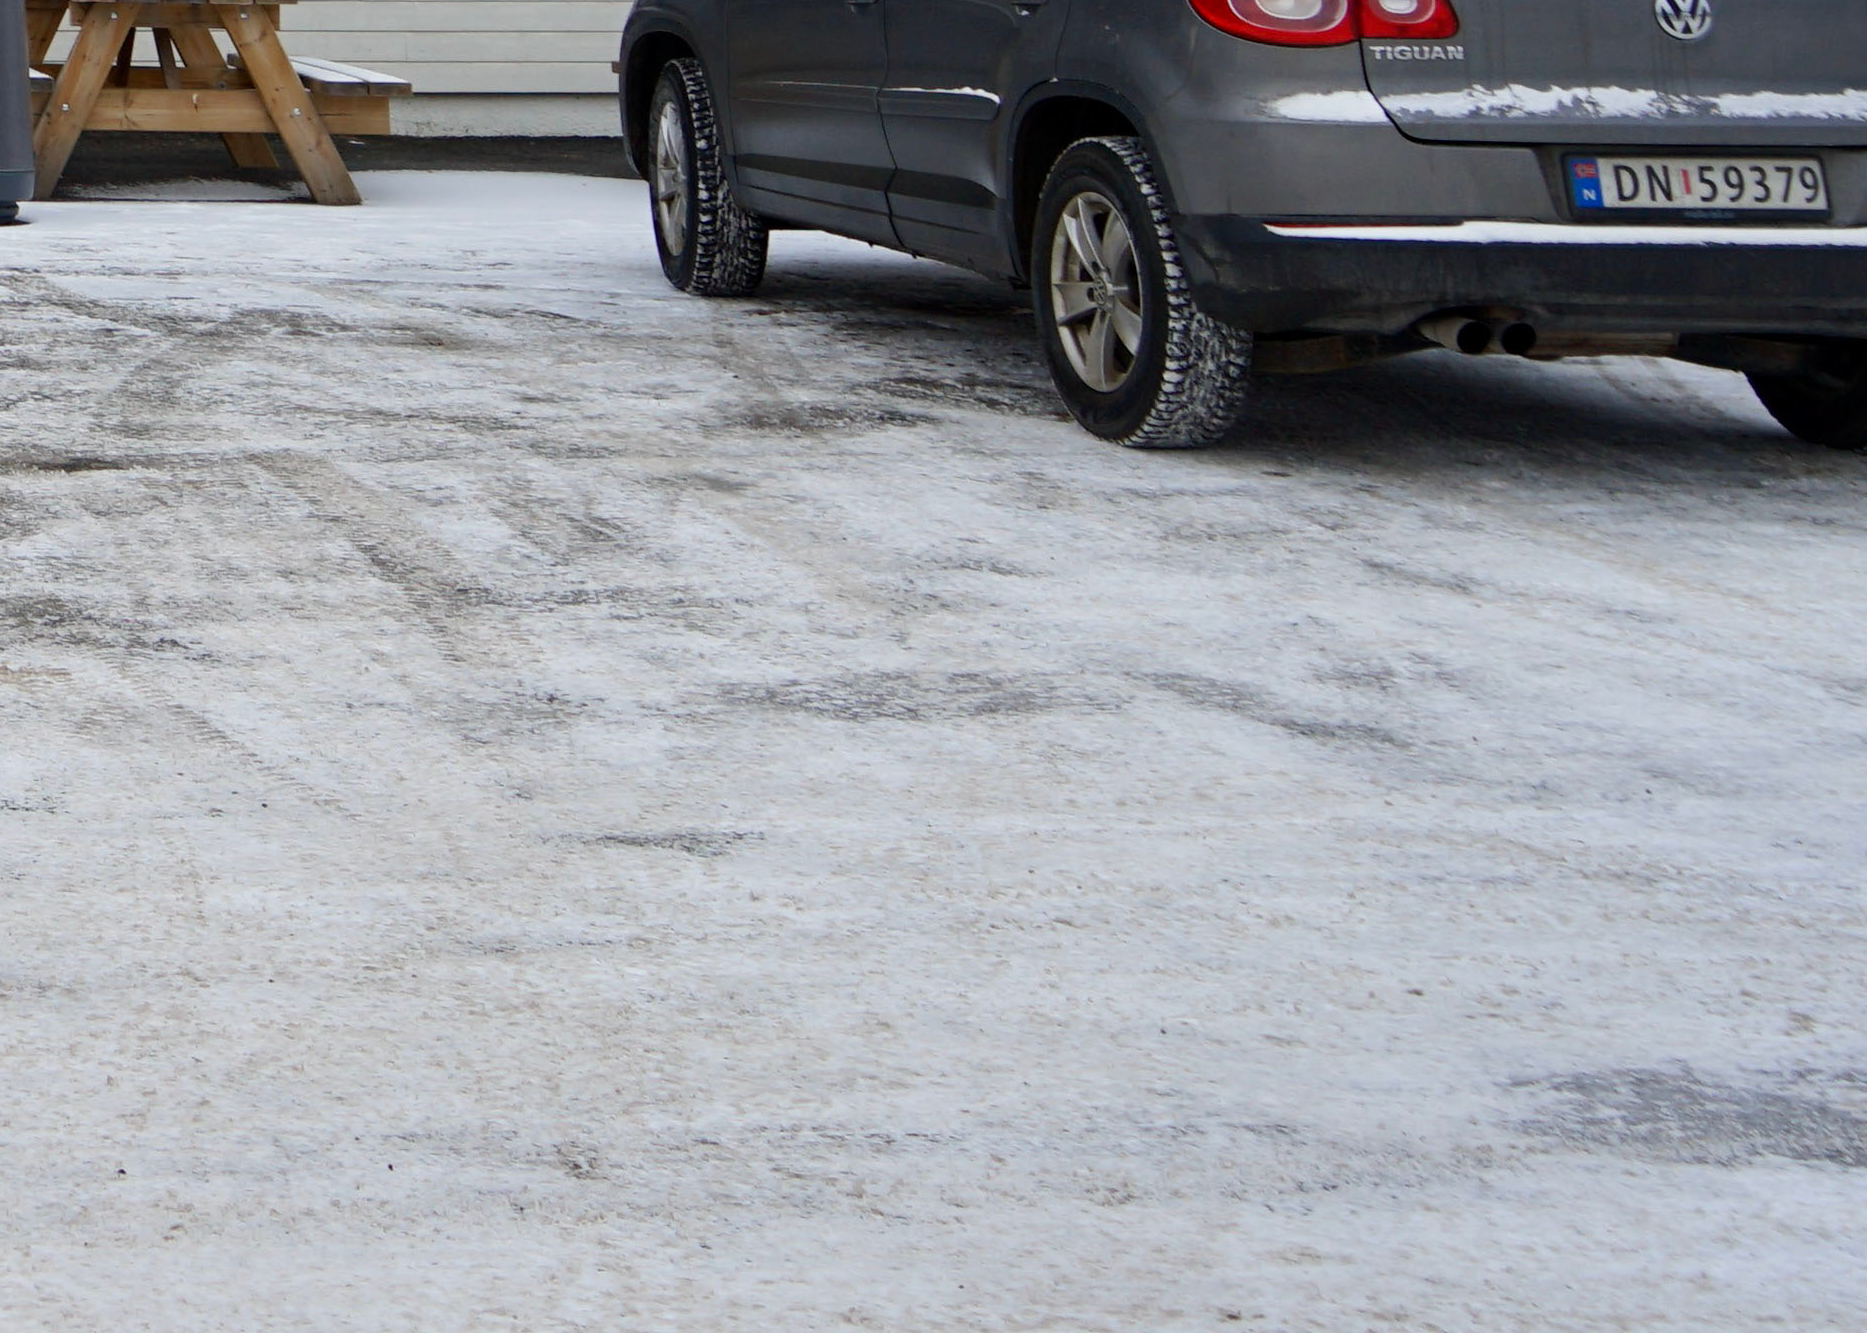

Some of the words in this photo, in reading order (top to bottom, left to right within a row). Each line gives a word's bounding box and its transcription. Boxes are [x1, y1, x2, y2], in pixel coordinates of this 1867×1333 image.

[1369, 45, 1465, 61] TIGUAN
[1582, 188, 1597, 201] N
[1613, 164, 1673, 202] DN
[1698, 165, 1820, 203] 59379
